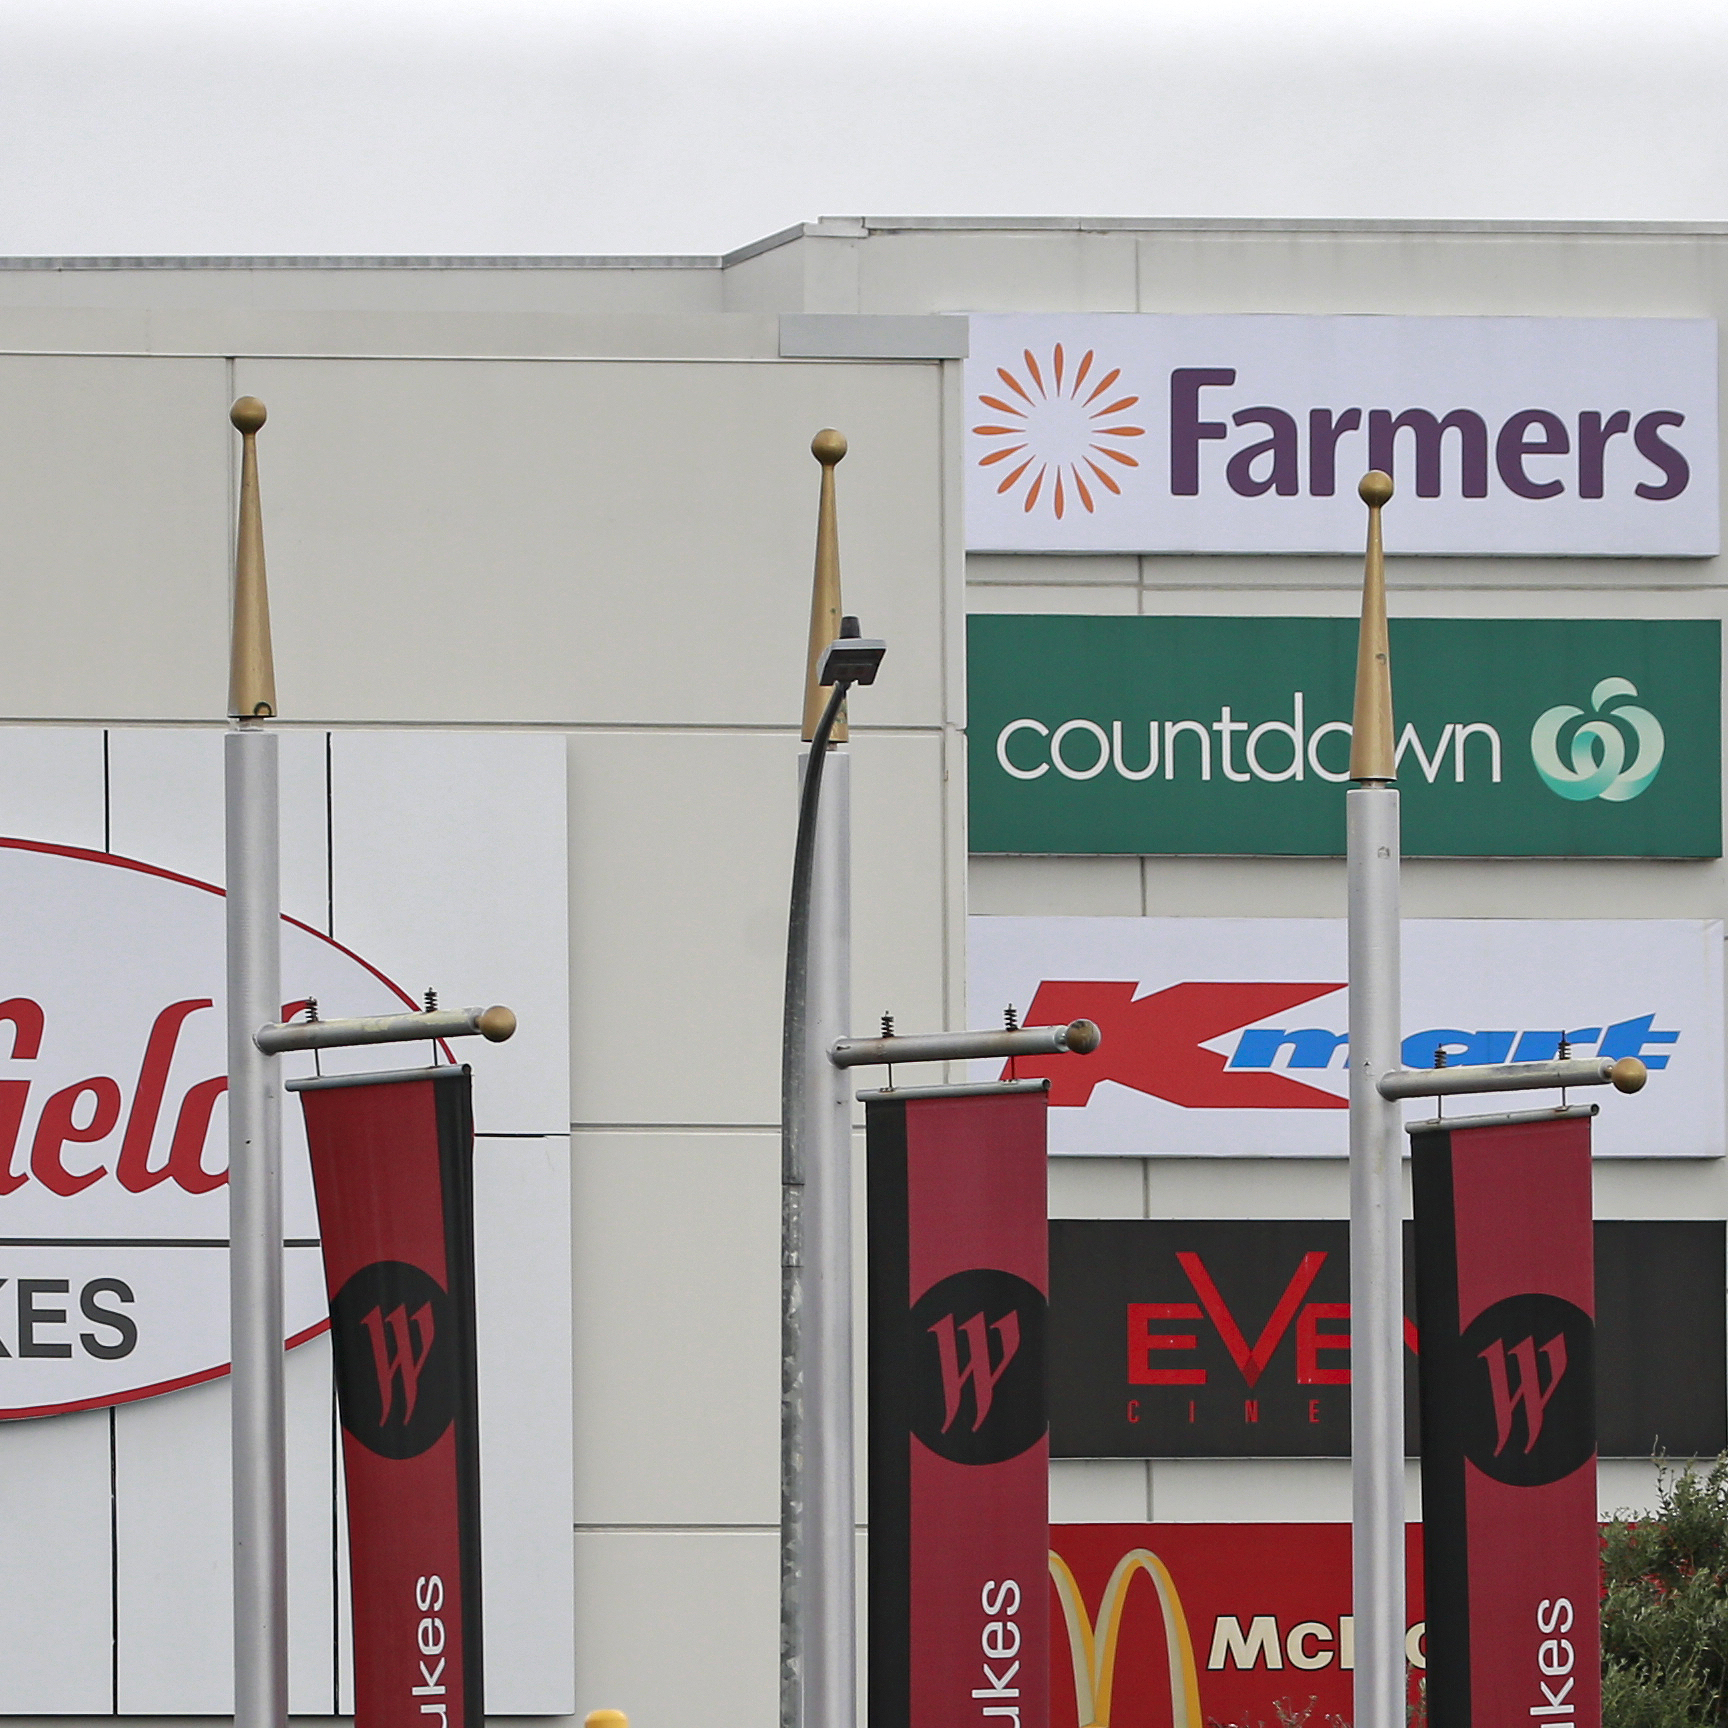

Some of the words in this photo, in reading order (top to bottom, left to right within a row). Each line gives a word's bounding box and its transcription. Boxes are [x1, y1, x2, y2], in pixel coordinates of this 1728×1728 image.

[1170, 367, 1692, 502] Farmers
[995, 692, 1502, 784] countdown
[1000, 981, 1681, 1109] Kmart
[360, 1301, 435, 1428] W
[927, 1309, 1022, 1433] W
[1127, 1251, 1420, 1386] EVE
[1127, 1399, 1321, 1424] CINE
[1477, 1333, 1569, 1457] W
